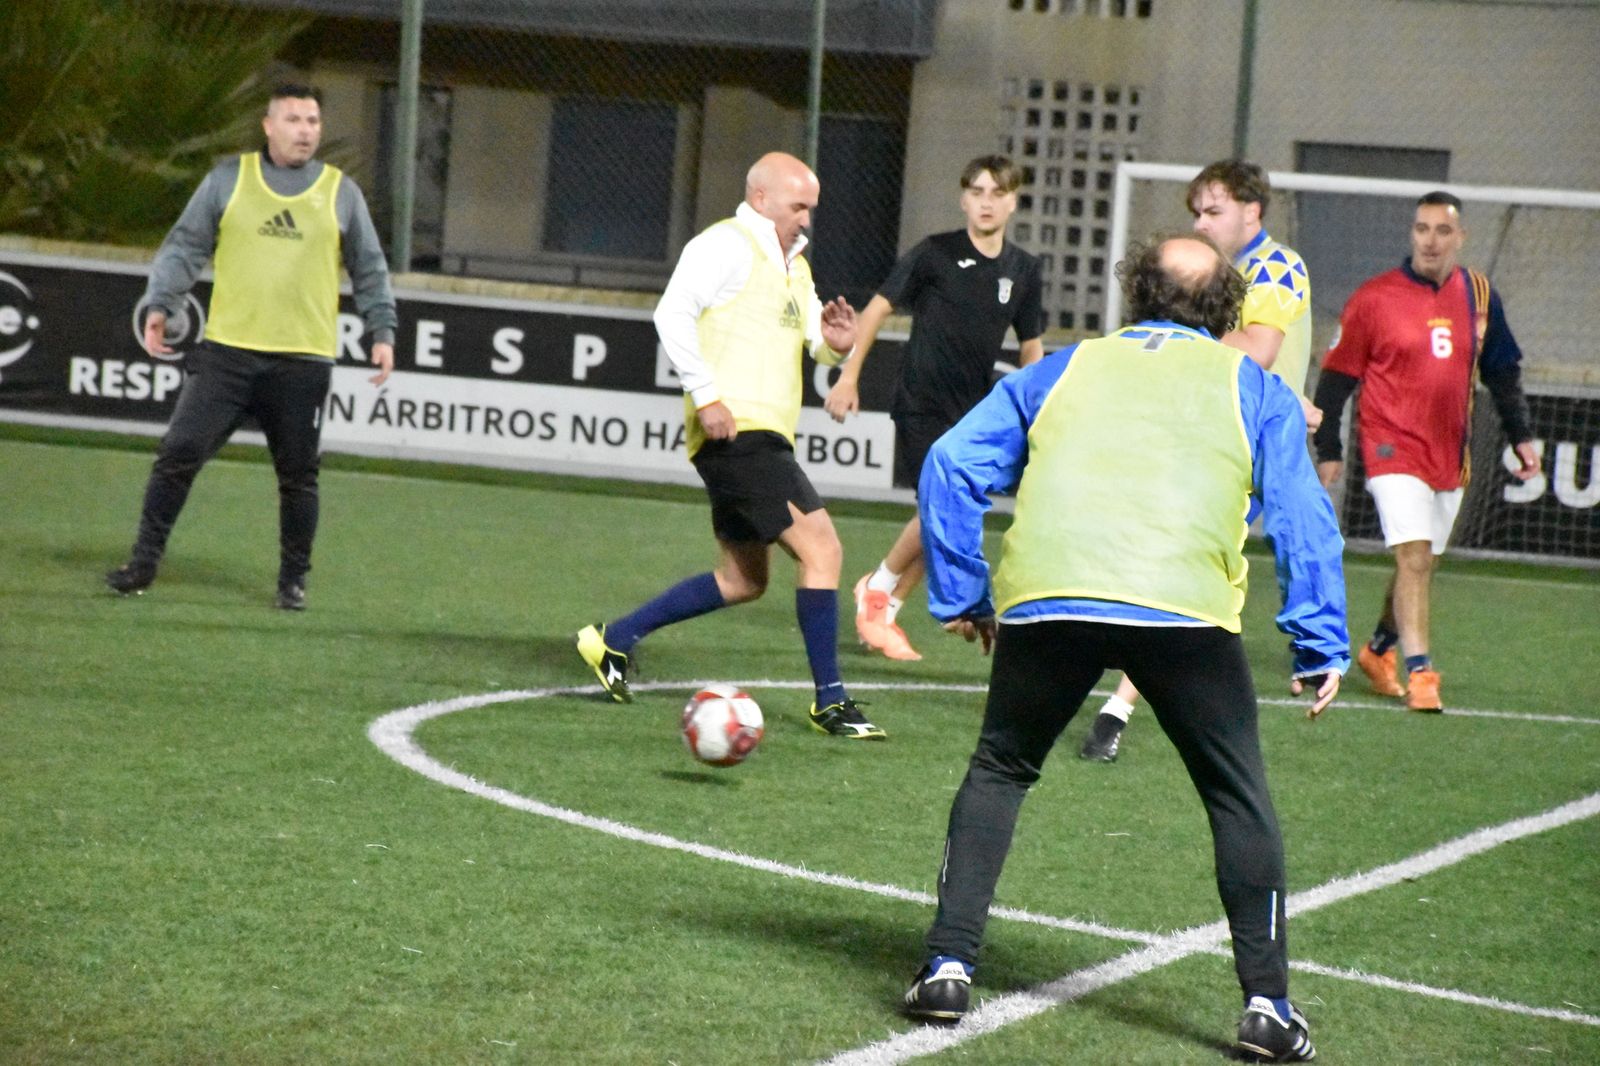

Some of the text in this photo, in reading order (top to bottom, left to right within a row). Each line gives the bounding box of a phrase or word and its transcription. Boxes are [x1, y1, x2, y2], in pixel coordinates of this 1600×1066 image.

[1431, 327, 1453, 358] 6
[368, 388, 556, 441] ÁRBITROS
[571, 416, 628, 447] NO
